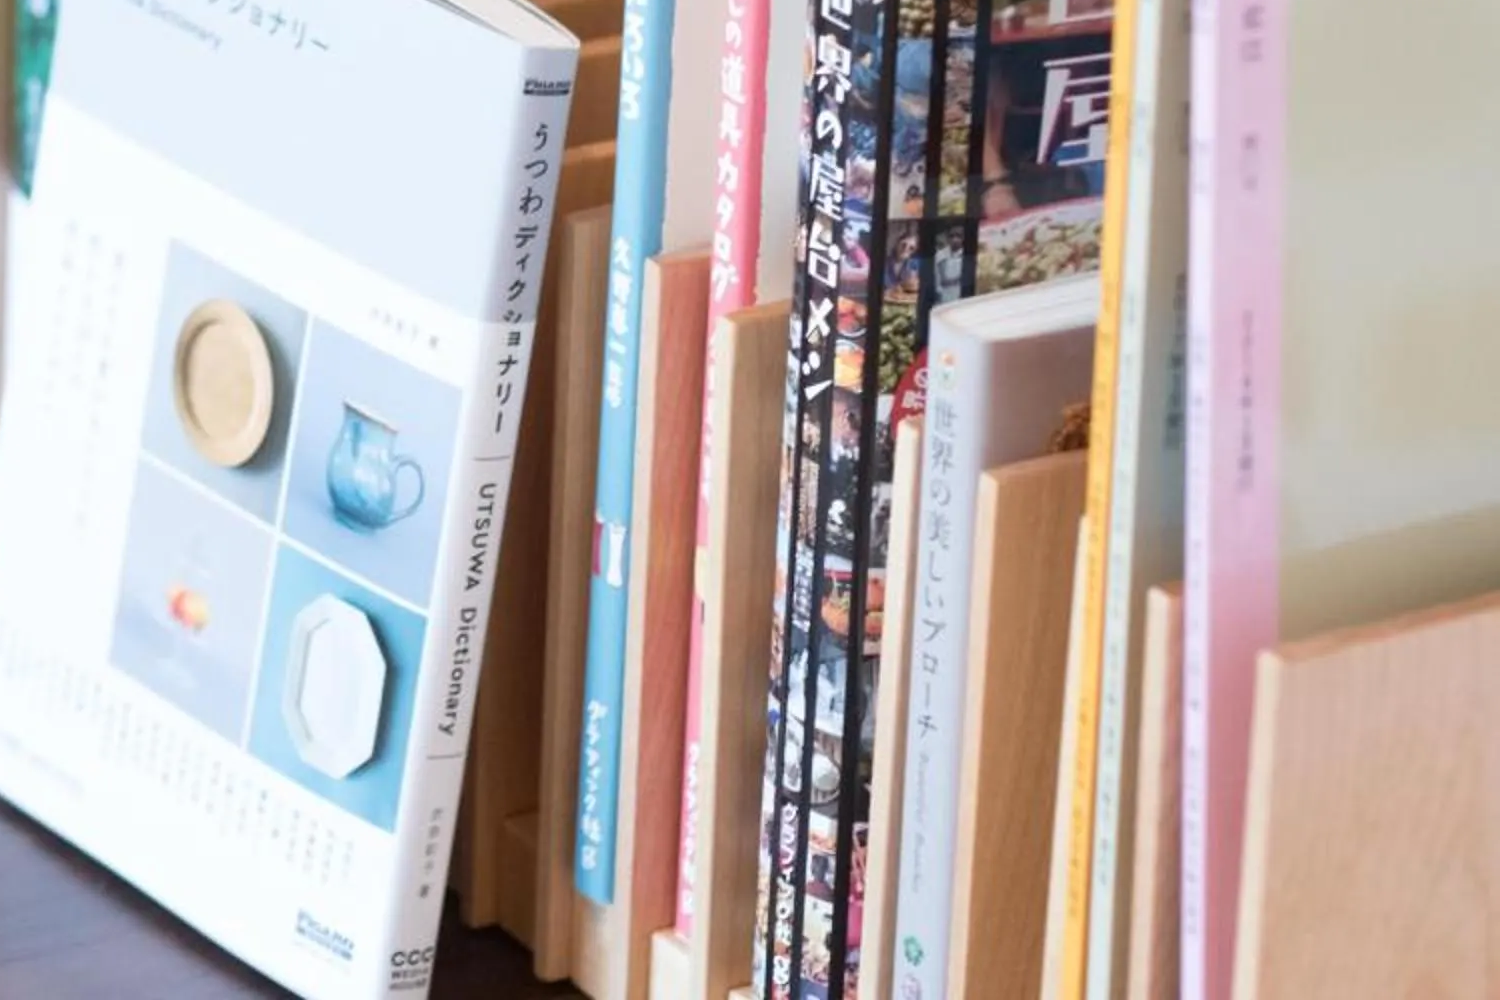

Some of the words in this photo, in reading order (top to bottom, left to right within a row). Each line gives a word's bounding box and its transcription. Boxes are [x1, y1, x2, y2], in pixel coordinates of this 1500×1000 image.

[495, 123, 550, 434] うつわディクショナリー
[464, 481, 499, 592] UTSUWA
[916, 398, 960, 739] 世界の美しいブローチ
[437, 606, 479, 738] Dictionary
